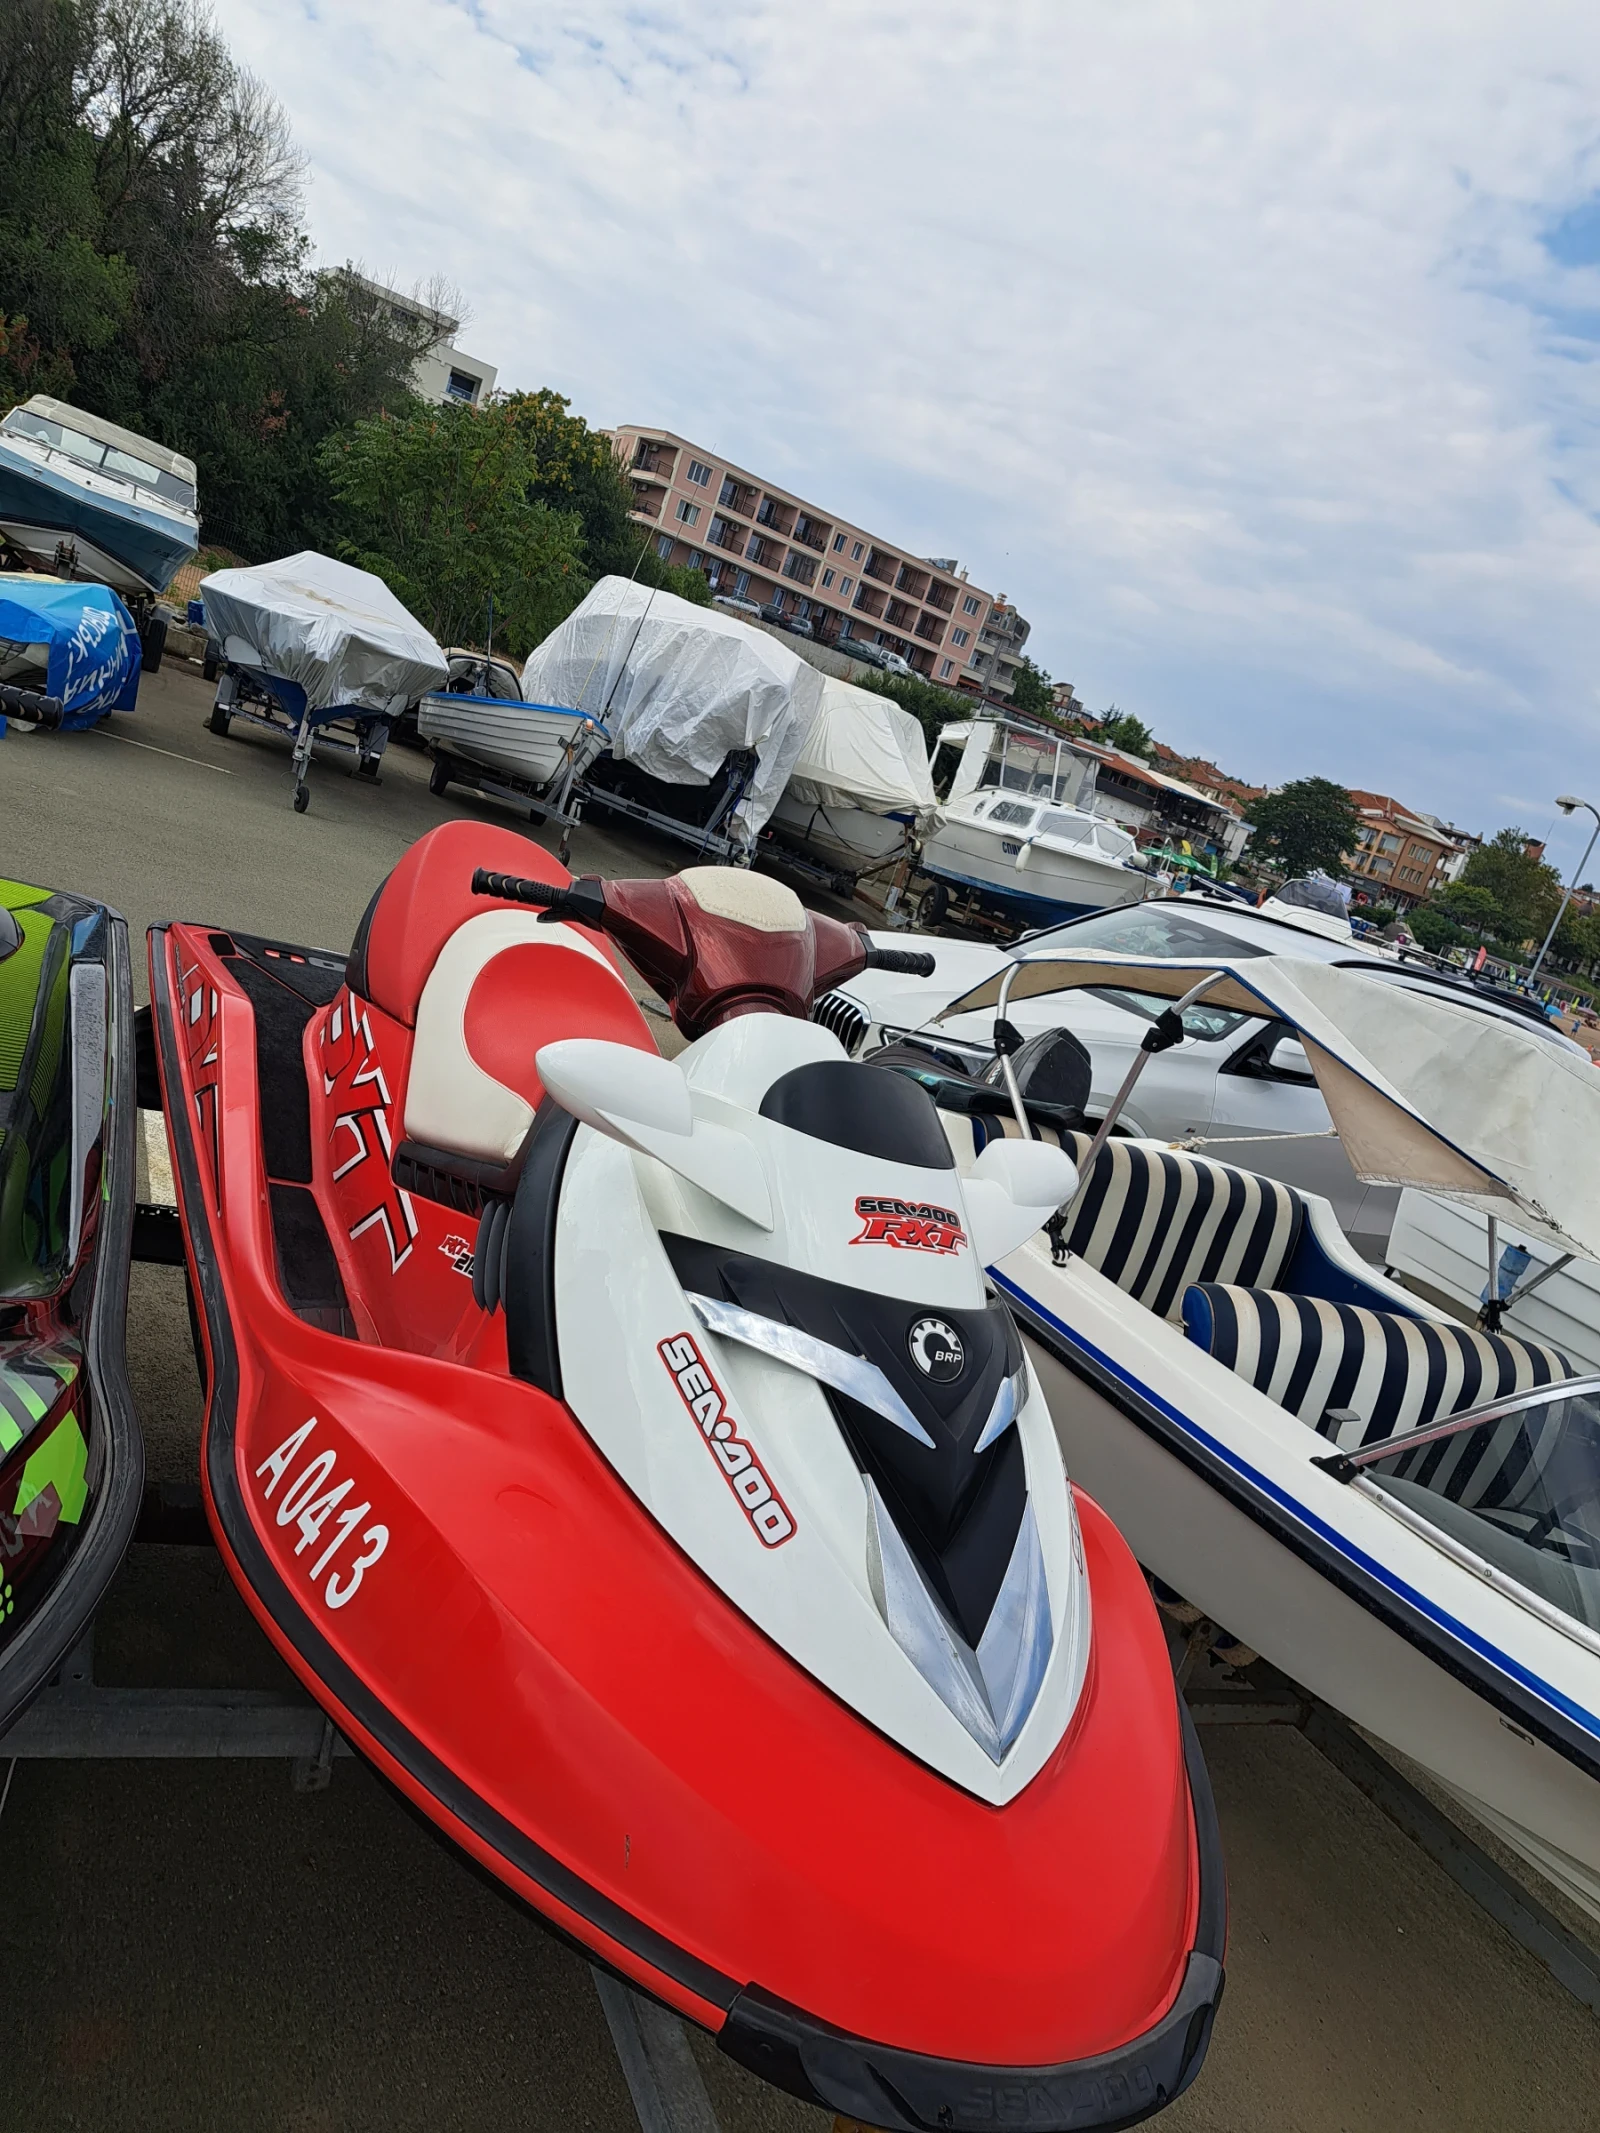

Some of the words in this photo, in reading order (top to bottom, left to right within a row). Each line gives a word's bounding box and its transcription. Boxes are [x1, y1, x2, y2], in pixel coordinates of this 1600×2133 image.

[865, 1219, 966, 1250] RXT
[934, 1350, 962, 1363] BRP
[276, 1450, 389, 1609] 0413
